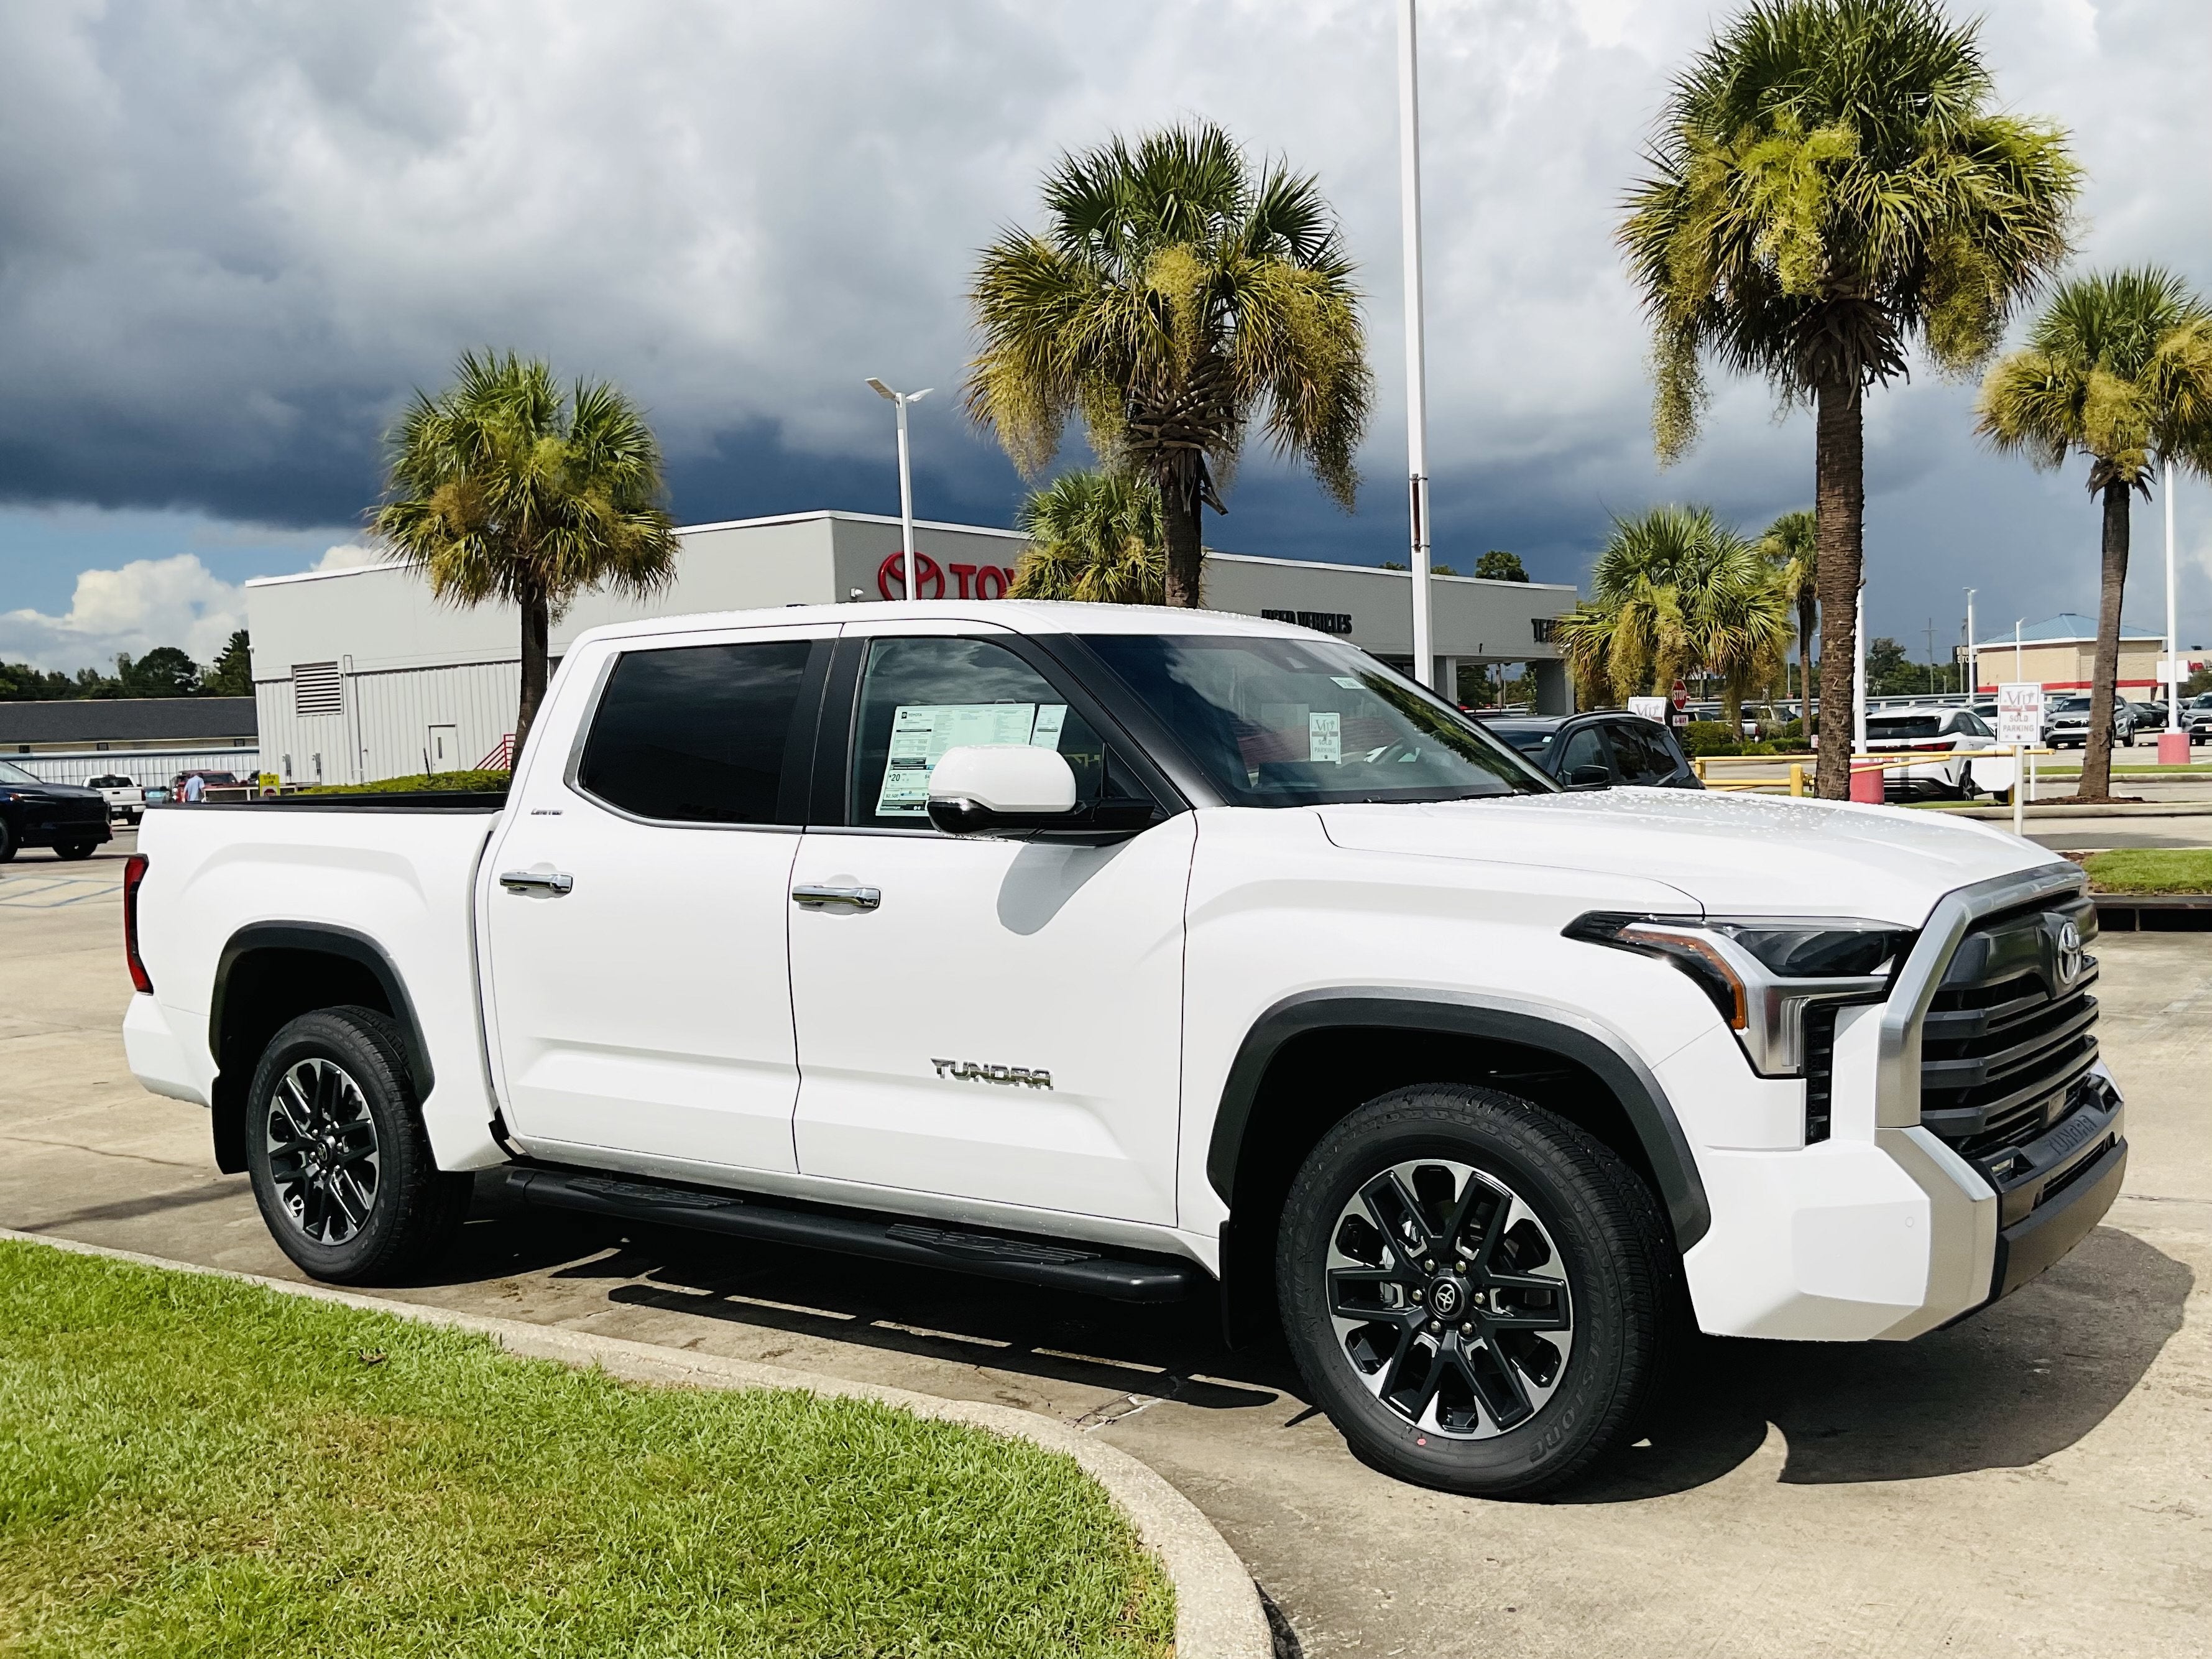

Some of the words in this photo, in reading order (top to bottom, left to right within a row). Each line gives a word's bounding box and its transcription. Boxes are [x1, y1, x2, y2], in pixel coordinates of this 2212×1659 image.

[1297, 611, 1352, 634] VEHICLES
[1673, 690, 1685, 700] STOP
[930, 1056, 1054, 1091] TUNDRA
[2044, 1114, 2098, 1156] TUNDRA
